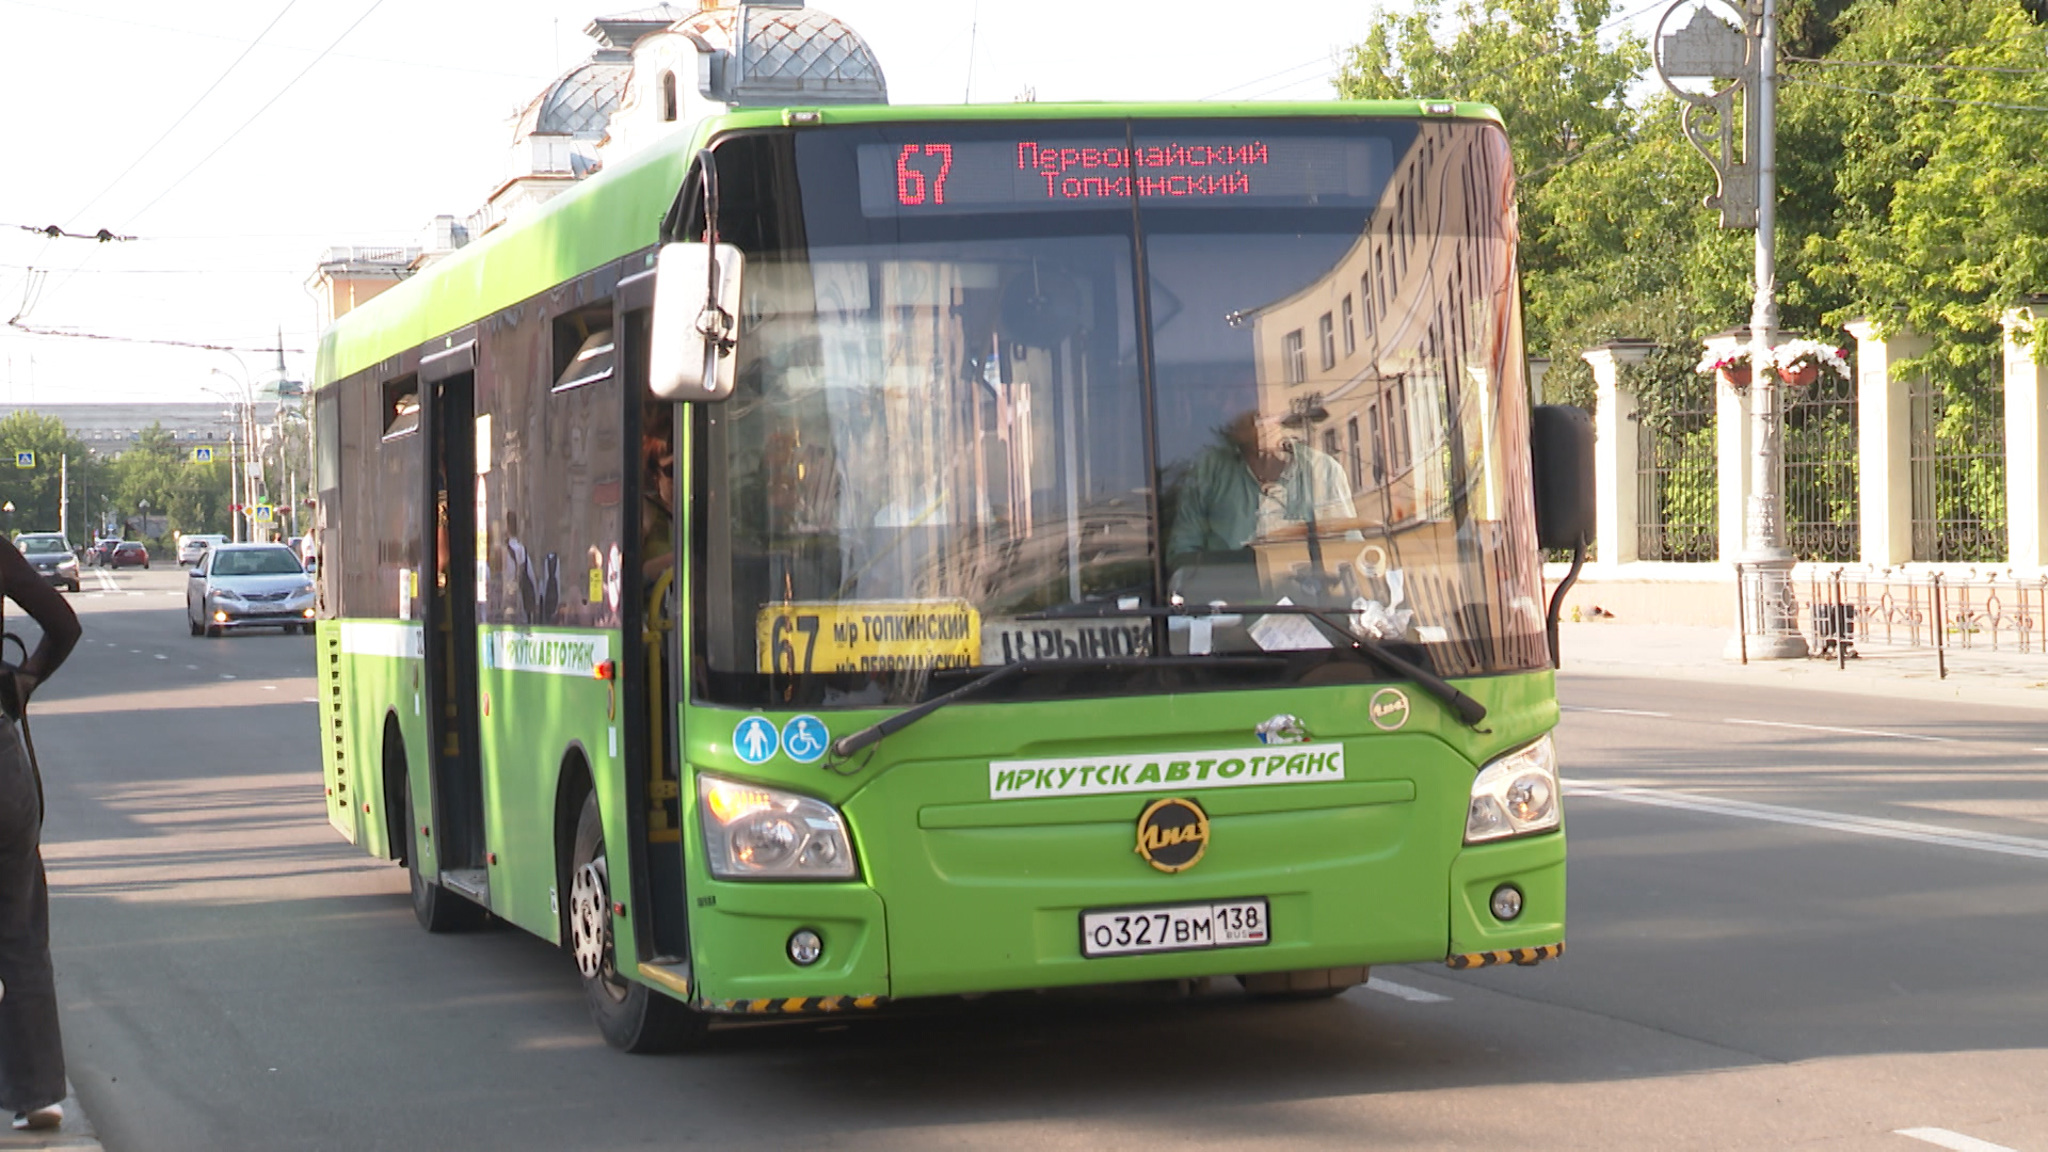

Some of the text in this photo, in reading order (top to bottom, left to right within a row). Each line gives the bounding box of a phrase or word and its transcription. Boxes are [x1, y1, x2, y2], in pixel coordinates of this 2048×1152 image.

[1017, 141, 1269, 172] Первомайский
[897, 143, 953, 205] 67
[1040, 169, 1250, 198] Топкинский
[502, 639, 595, 670] РКУТСКАВТОТРАНС
[771, 615, 820, 673] 67
[995, 751, 1342, 792] ИРКУТСКАВТОТРАНС
[1216, 905, 1259, 931] 138
